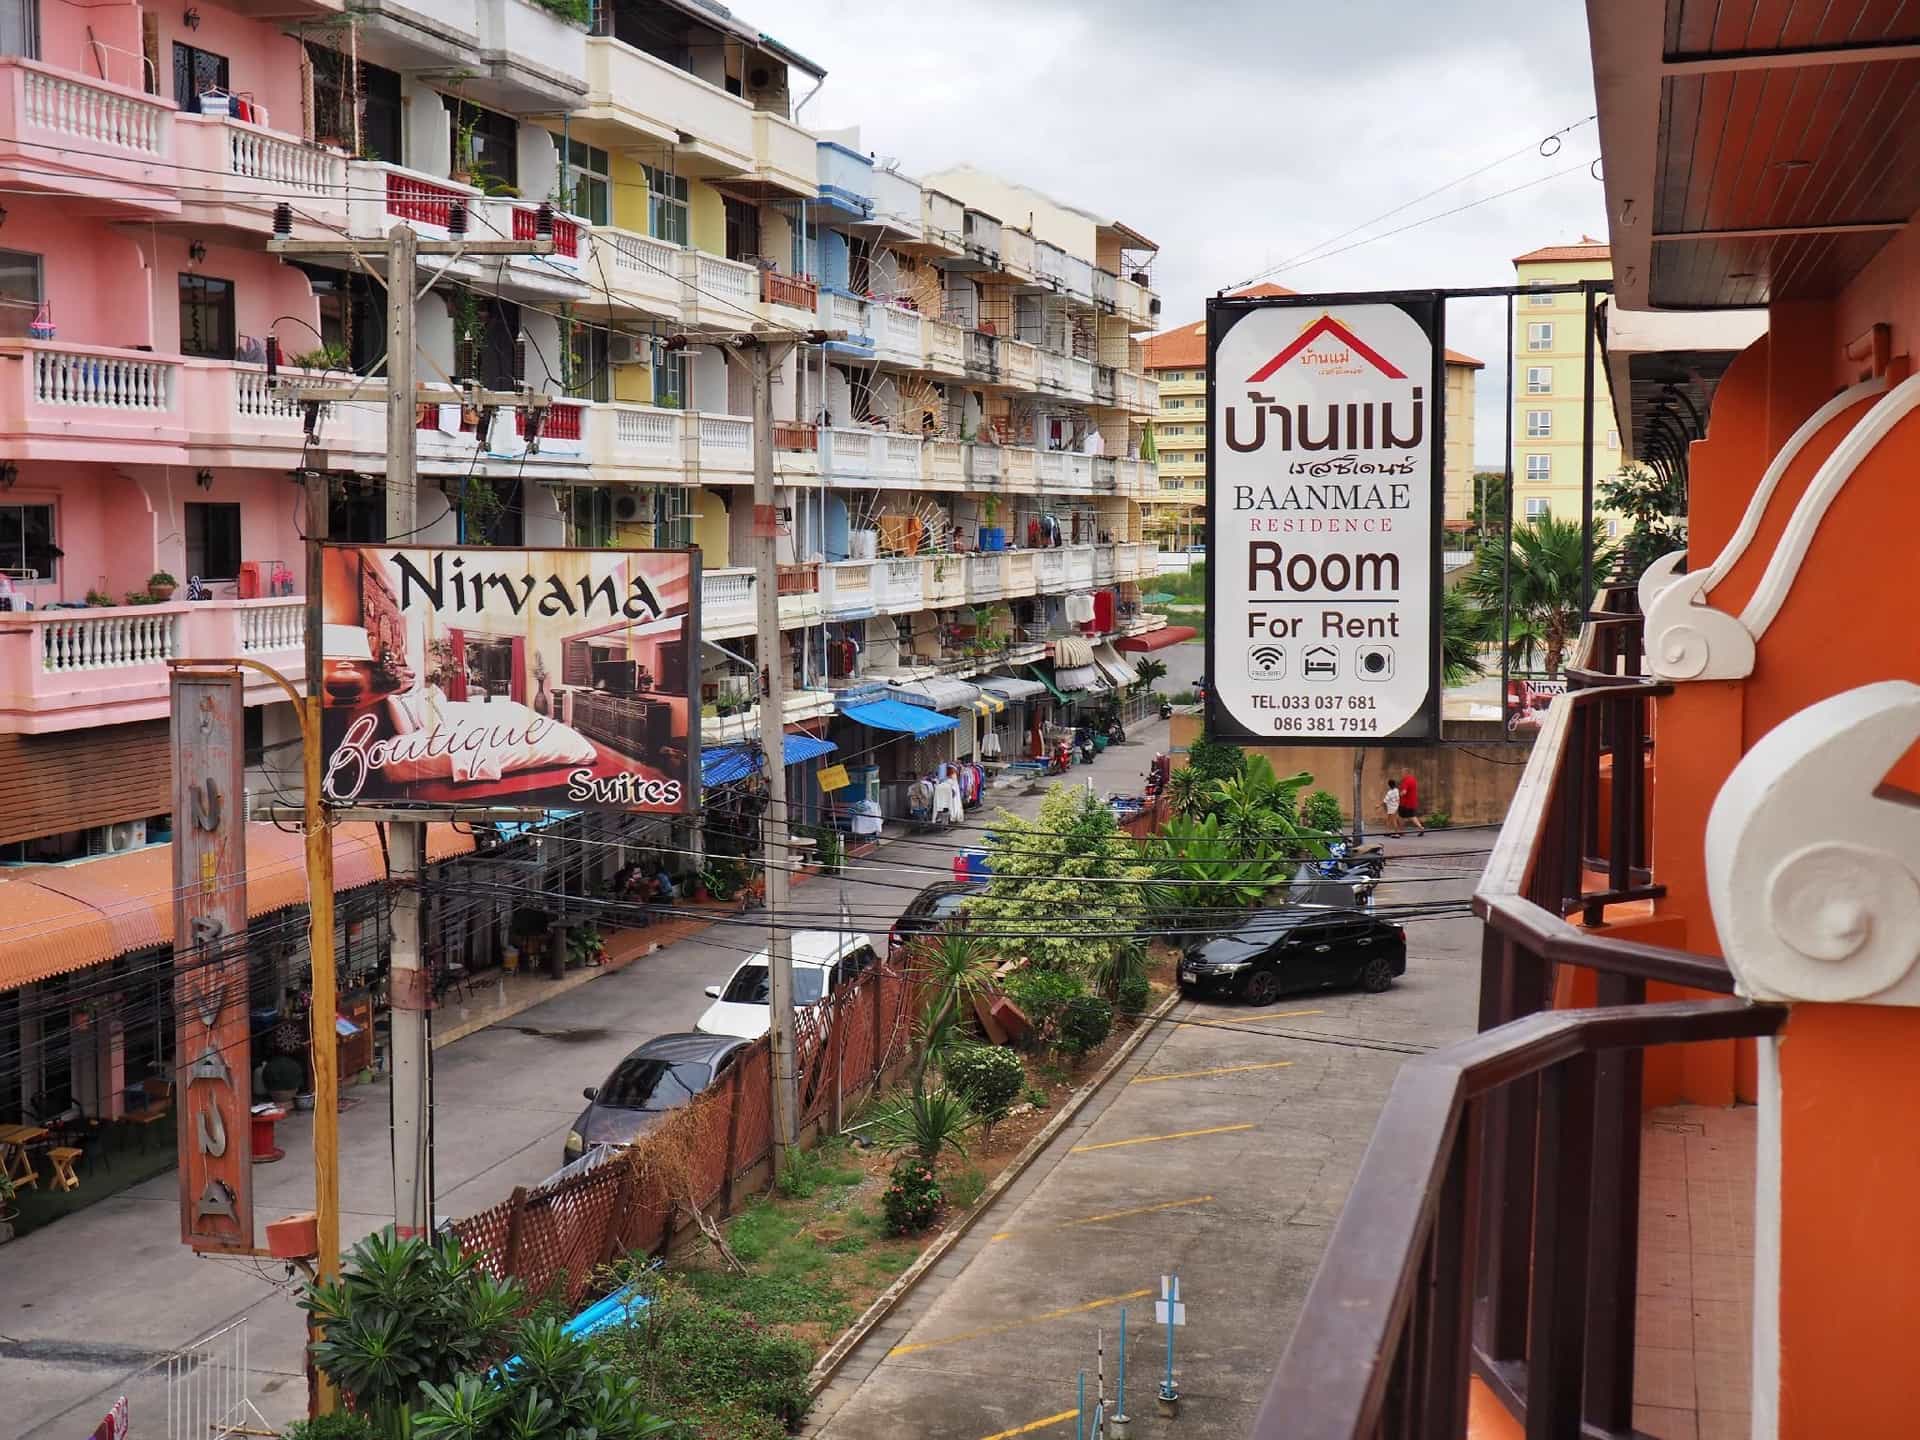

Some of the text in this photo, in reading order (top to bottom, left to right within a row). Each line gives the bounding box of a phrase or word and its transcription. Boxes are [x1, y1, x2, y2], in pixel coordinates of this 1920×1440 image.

[1225, 387, 1423, 453] บ้านแม่
[1233, 483, 1410, 511] BAANMAE
[1250, 518, 1392, 532] RESIDENCE
[1248, 540, 1400, 592] Room
[391, 551, 667, 619] Nirvana
[1248, 611, 1400, 638] For Rent
[1315, 695, 1343, 710] 037
[1348, 694, 1377, 709] 681
[1526, 682, 1566, 695] Nirva
[1274, 717, 1378, 732] 086 381 7914
[322, 712, 556, 801] Boutique
[567, 769, 682, 806] Suites
